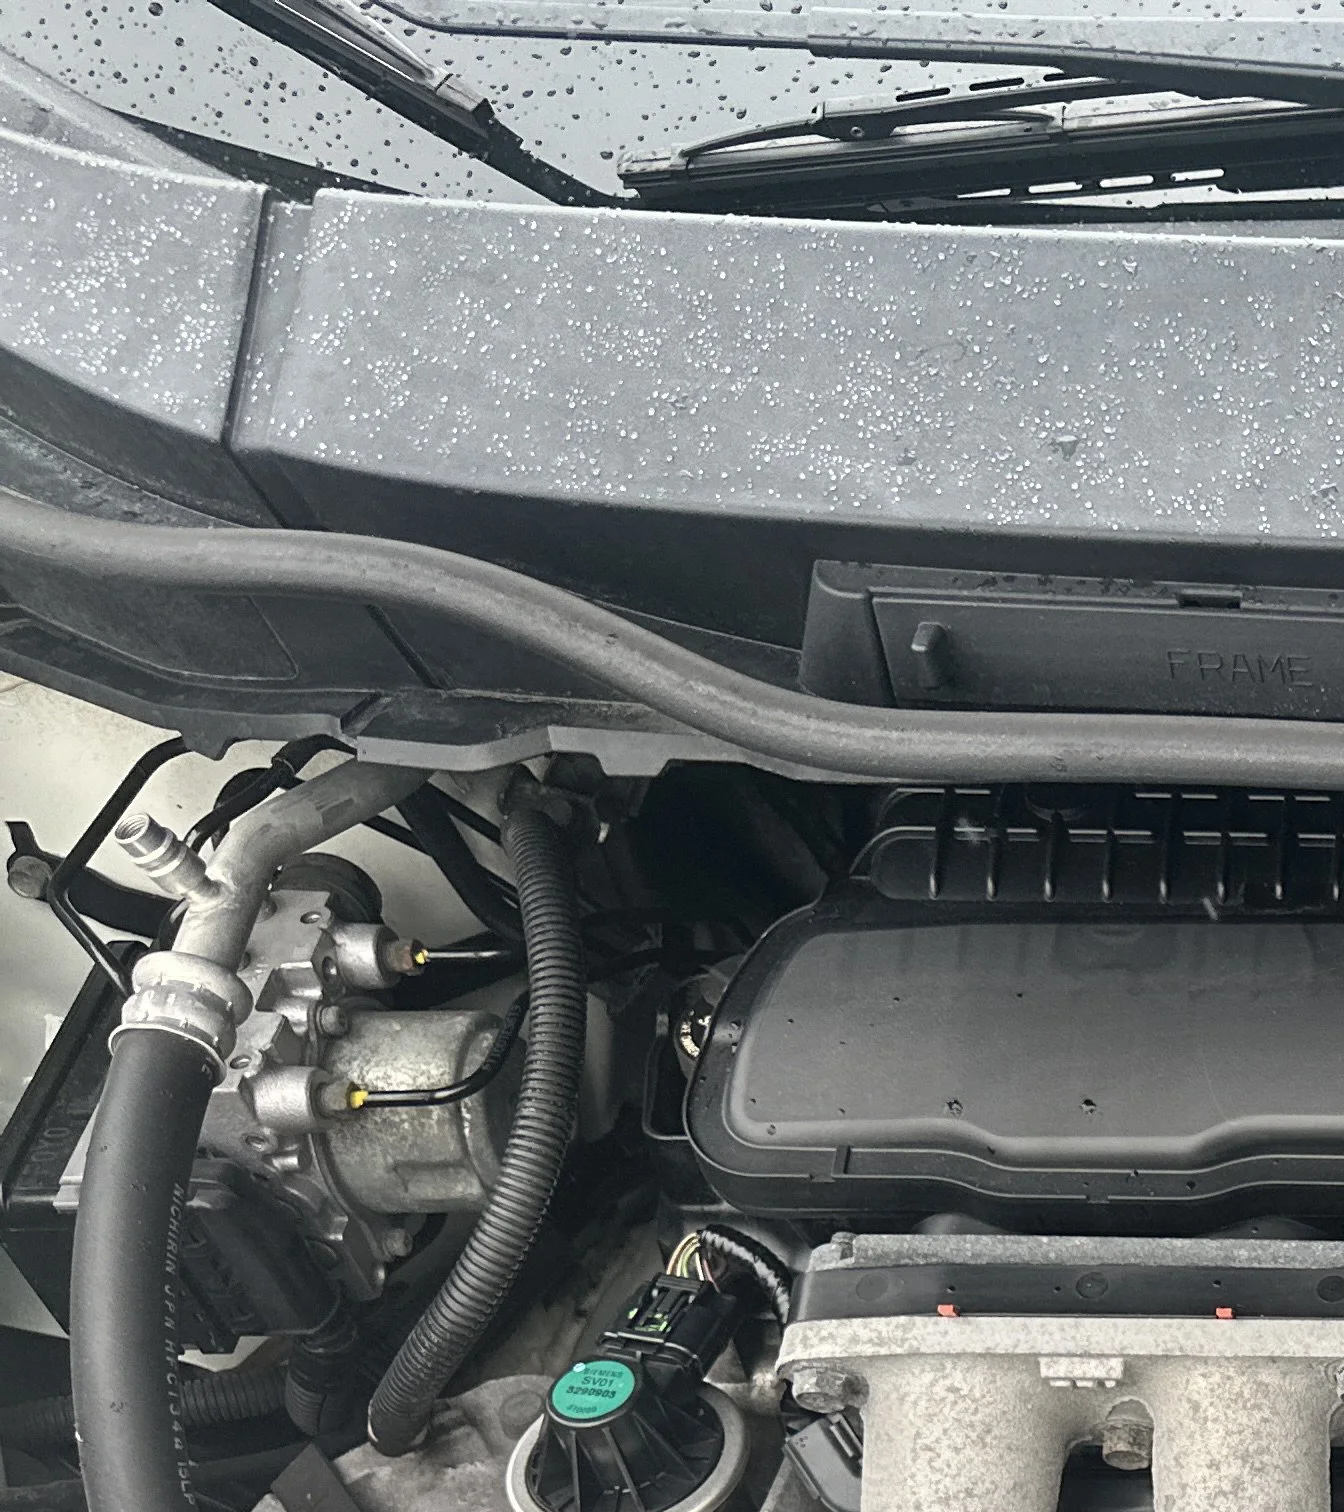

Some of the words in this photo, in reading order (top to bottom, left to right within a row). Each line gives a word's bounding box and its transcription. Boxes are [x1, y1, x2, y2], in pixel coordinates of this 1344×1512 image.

[1166, 648, 1315, 688] FRAME
[164, 1182, 186, 1276] NICHIRIN
[164, 1284, 177, 1330] JPN
